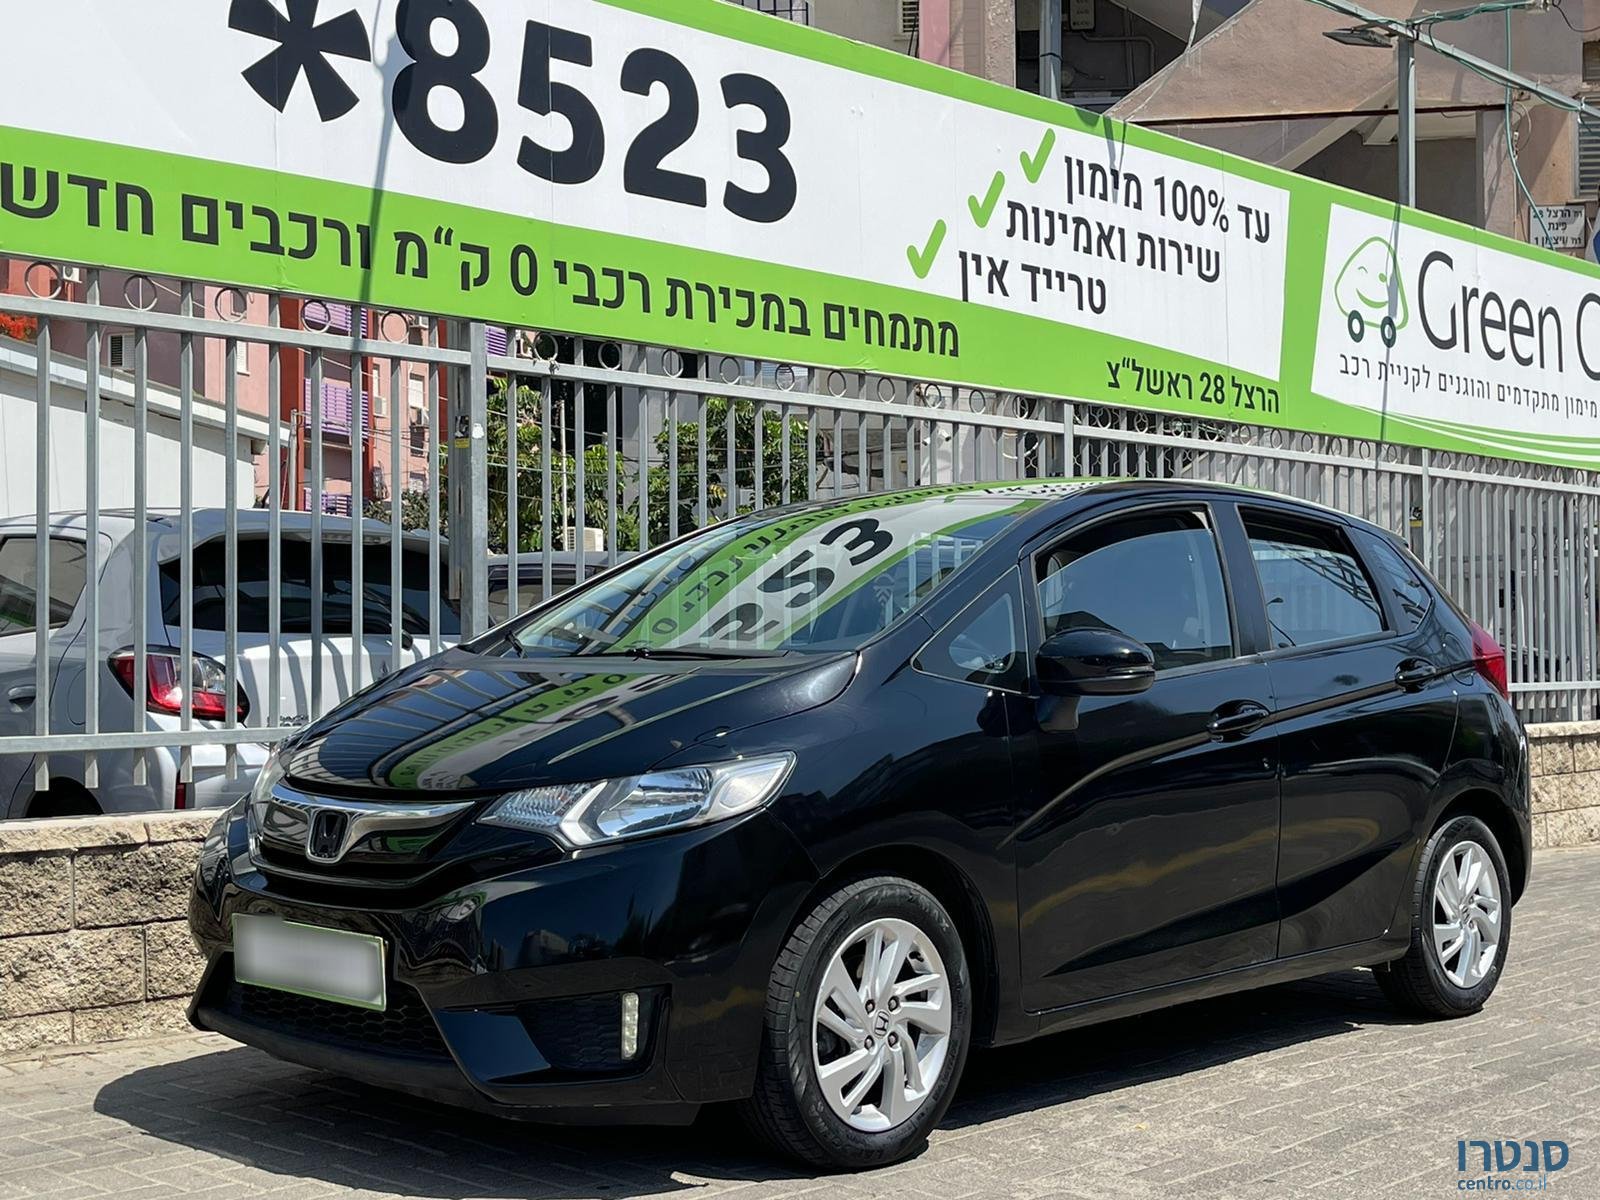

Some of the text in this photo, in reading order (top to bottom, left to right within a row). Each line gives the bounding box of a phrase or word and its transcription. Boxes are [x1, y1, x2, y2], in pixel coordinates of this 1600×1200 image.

[1064, 155, 1271, 244] עד 100% מימון
[1547, 221, 1567, 231] פינת
[180, 192, 373, 270] ורכבים
[1005, 199, 1220, 283] שירות ואמינות
[510, 243, 539, 297] 0
[553, 259, 651, 314] רכבי
[958, 250, 1107, 315] טרייד אין
[665, 277, 811, 337] במכירת
[823, 302, 960, 358] מתמחים
[1417, 250, 1564, 373] Green
[1199, 371, 1226, 405] 28
[1231, 375, 1280, 414] הרצל
[1339, 353, 1599, 419] מימון מתקדמים והוגנים לקניית רכב
